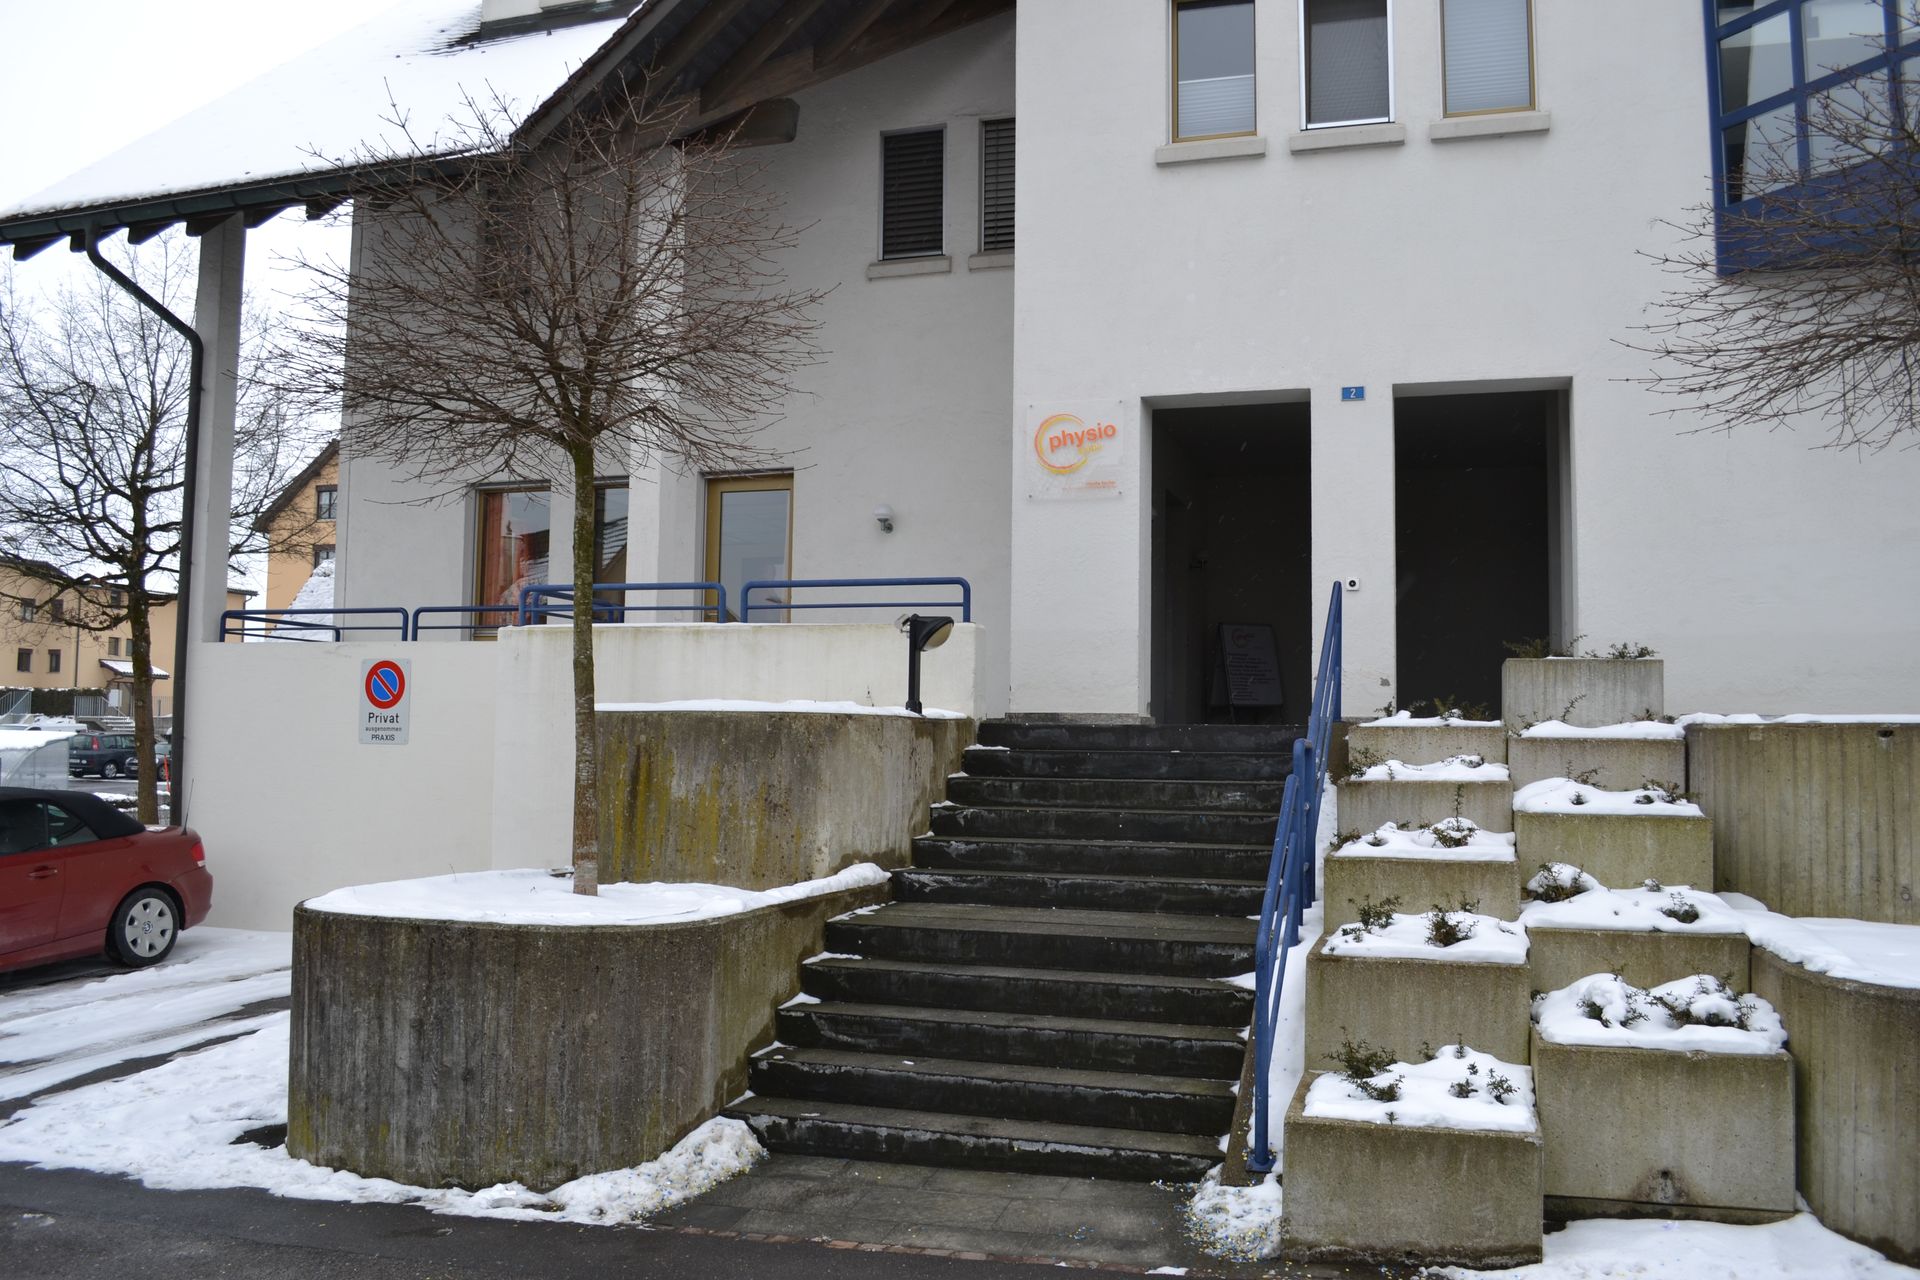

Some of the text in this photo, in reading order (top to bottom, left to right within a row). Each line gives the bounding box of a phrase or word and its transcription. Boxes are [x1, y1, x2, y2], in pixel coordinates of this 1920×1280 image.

[1350, 388, 1356, 398] 2
[1049, 422, 1117, 453] physio
[368, 712, 399, 723] Privat
